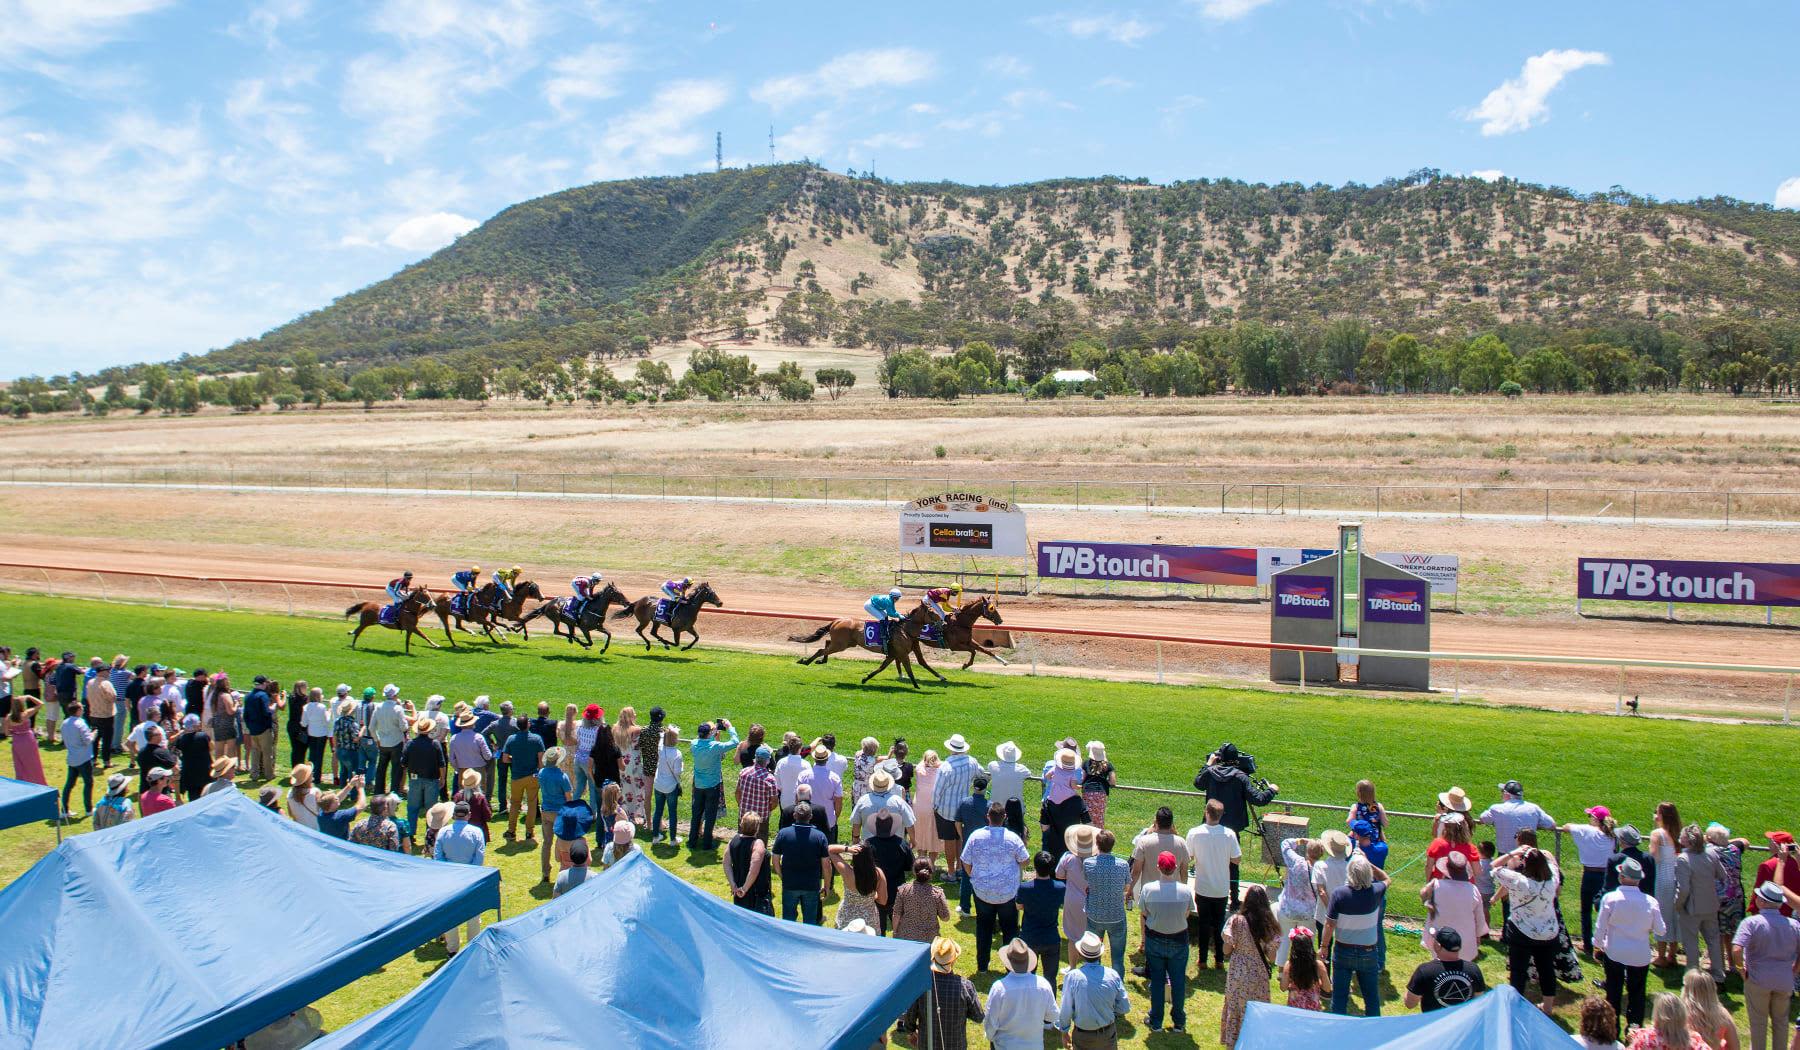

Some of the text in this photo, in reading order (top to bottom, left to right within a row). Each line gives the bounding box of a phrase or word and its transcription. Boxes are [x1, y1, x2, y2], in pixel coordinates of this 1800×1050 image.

[916, 495, 941, 508] YORK
[945, 493, 983, 503] RACING
[933, 528, 989, 538] Cellarbrations
[1042, 546, 1170, 578] TABtouch
[1584, 562, 1756, 600] TABtouch
[452, 596, 460, 609] 4
[1279, 593, 1330, 607] TABtouch
[1368, 598, 1421, 612] TABtouch
[656, 604, 665, 616] 5
[866, 626, 875, 640] 6
